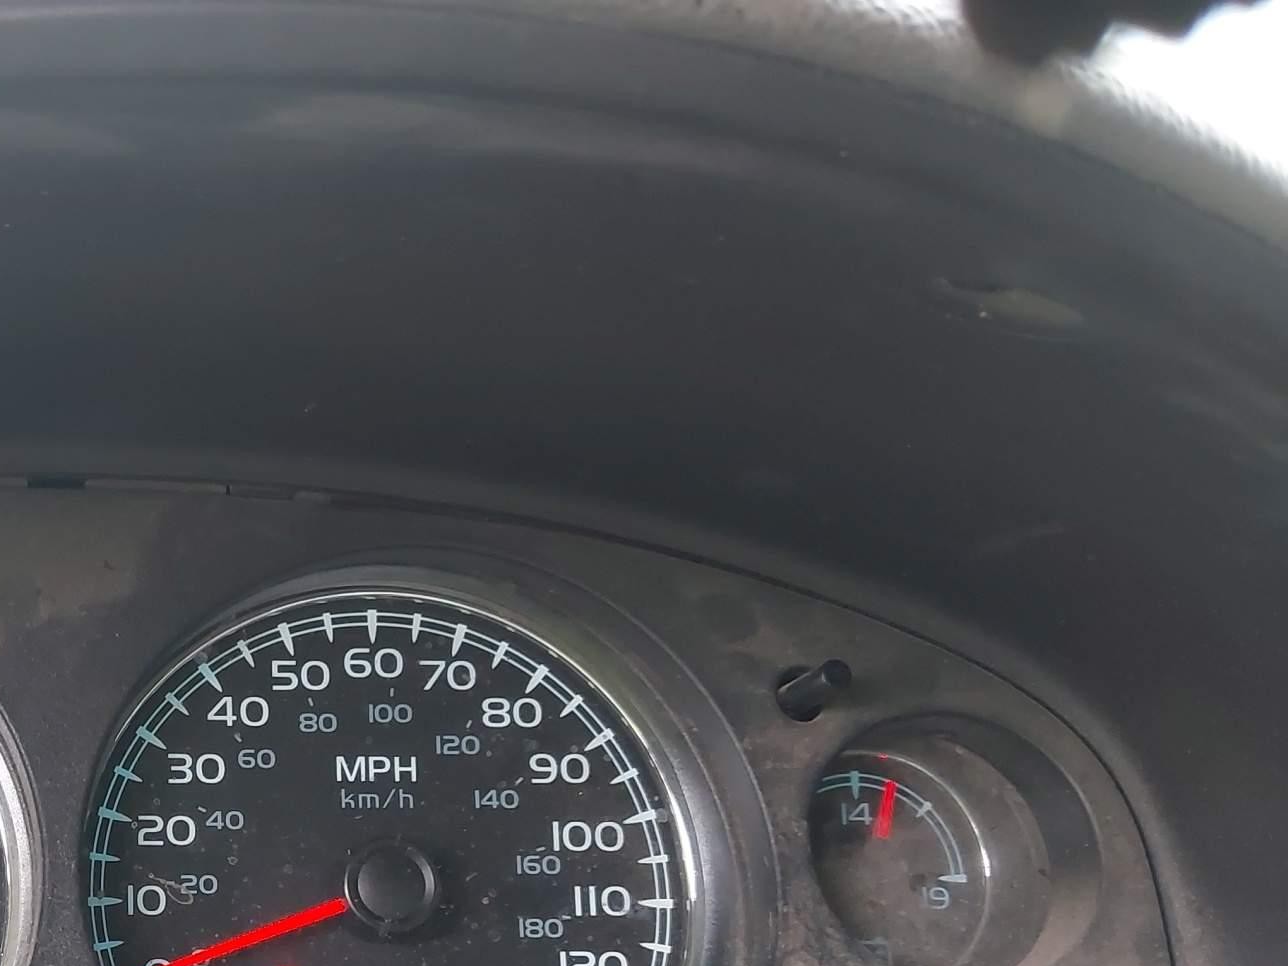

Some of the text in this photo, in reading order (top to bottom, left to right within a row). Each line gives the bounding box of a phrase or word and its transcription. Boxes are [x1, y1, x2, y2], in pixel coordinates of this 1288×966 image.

[271, 662, 330, 690] 50
[344, 649, 403, 678] 60
[419, 662, 476, 690] 70
[207, 698, 270, 727] 40
[299, 714, 337, 733] 80
[368, 704, 412, 723] 100
[482, 699, 541, 728] 80
[435, 736, 480, 755] 120
[167, 755, 225, 784] 30
[238, 750, 276, 769] 60
[336, 757, 417, 782] MPH
[529, 755, 589, 784] 90
[341, 790, 414, 809] km/h
[474, 790, 518, 809] 140
[206, 812, 244, 830] 40
[842, 803, 872, 825] 14
[137, 816, 195, 845] 20
[553, 822, 624, 851] 100
[516, 856, 560, 875] 160
[180, 875, 218, 895] 20
[126, 886, 167, 915] 10
[573, 887, 630, 916] 110
[518, 919, 563, 938] 180
